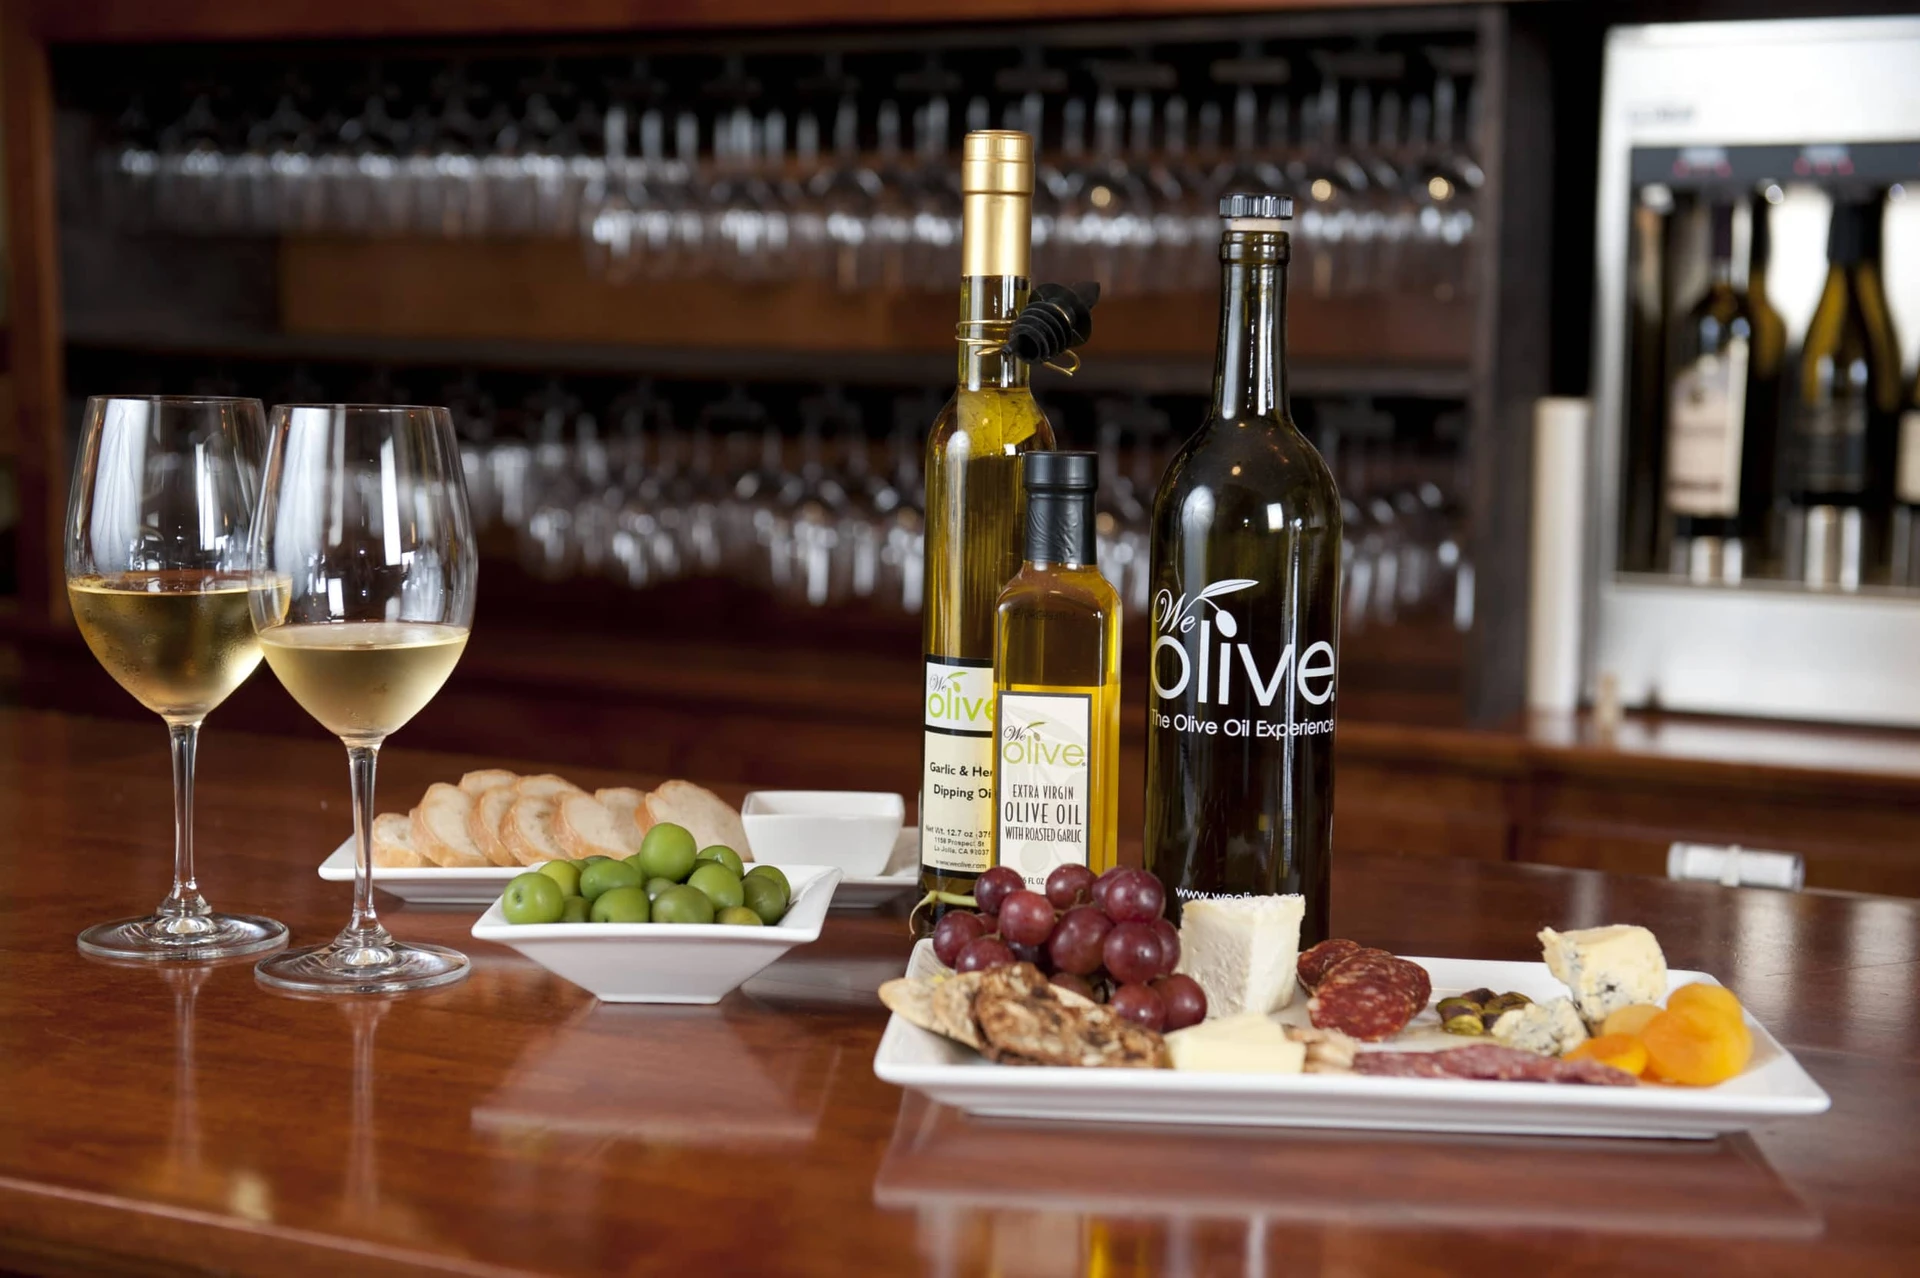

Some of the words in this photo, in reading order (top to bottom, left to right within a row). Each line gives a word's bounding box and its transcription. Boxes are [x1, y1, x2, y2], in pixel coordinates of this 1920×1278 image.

[1154, 588, 1197, 633] We
[930, 674, 947, 692] We
[1003, 725, 1027, 741] We
[1152, 708, 1170, 728] The
[1174, 714, 1218, 735] Olive
[1223, 719, 1250, 737] Oil
[1256, 718, 1334, 741] Experience
[1003, 734, 1085, 767] olive
[930, 762, 956, 775] Garlic
[959, 766, 968, 777] &
[934, 784, 974, 801] Dipping
[1013, 784, 1039, 798] EXTRA
[1043, 786, 1074, 800] VIRGIN
[1005, 802, 1049, 824] OLIVE
[1056, 804, 1082, 825] OIL
[948, 839, 975, 847] Prospect
[1005, 826, 1024, 840] WITH
[1025, 827, 1056, 842] ROASTED
[1057, 829, 1082, 843] GARLIC
